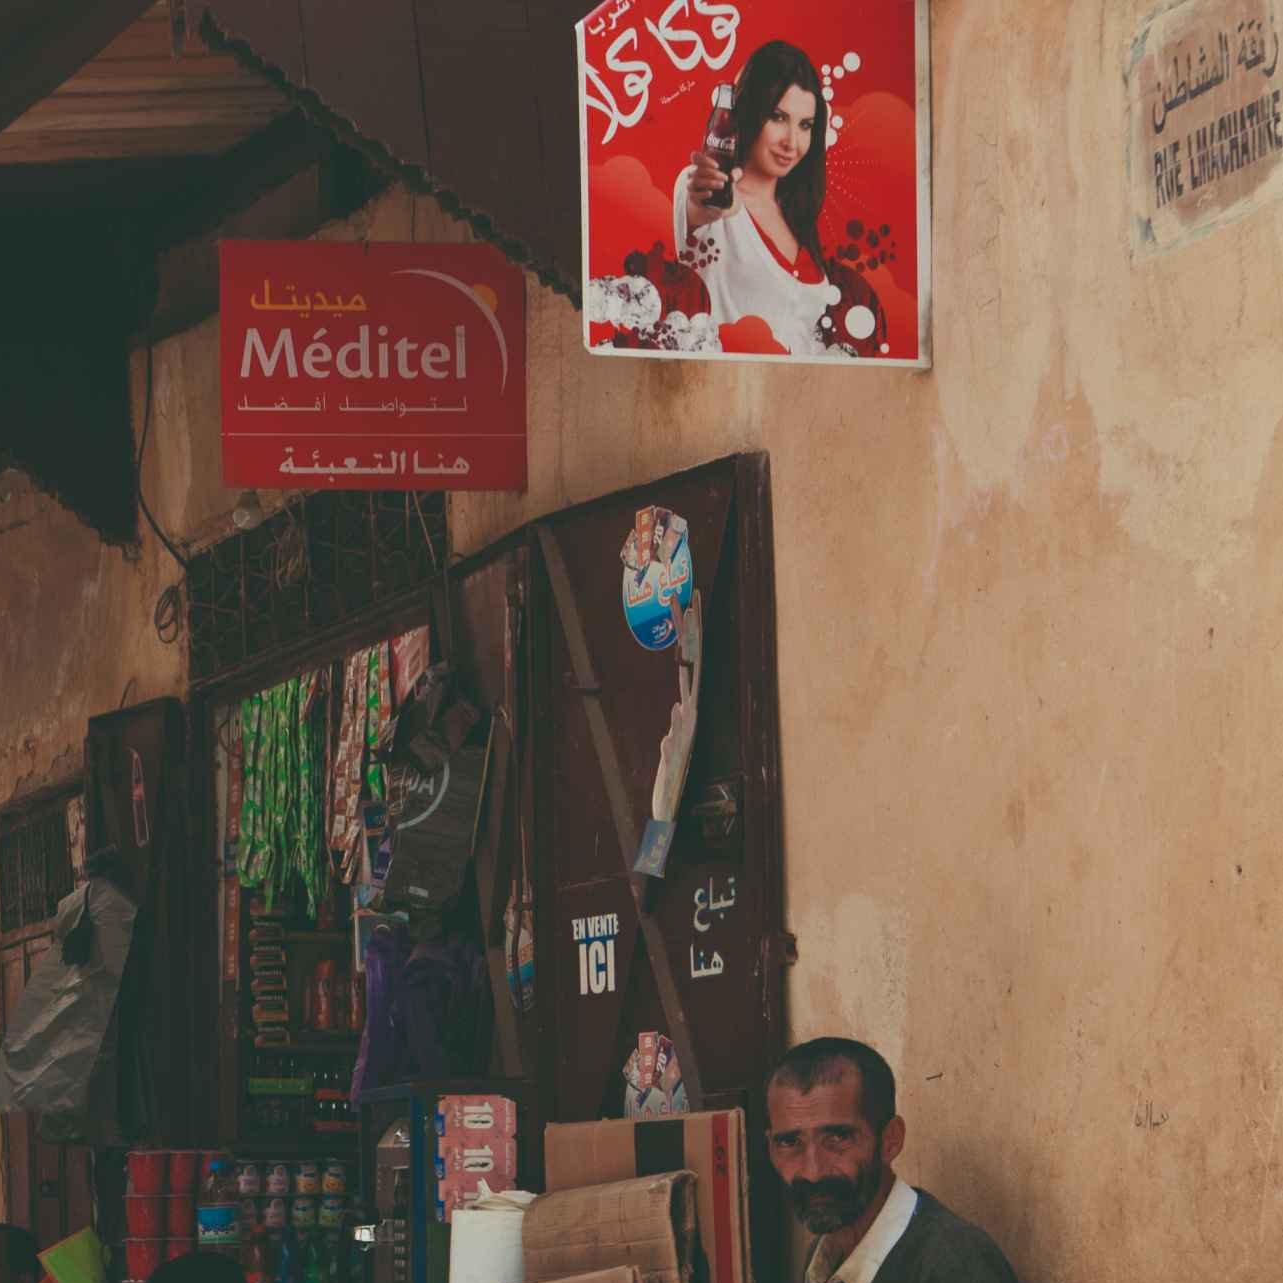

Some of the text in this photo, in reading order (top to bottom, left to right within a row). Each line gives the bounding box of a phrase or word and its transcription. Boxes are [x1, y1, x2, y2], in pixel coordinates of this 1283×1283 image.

[1154, 140, 1184, 209] RUE
[250, 279, 368, 319] ميديتل
[240, 324, 467, 380] Méditel
[279, 446, 470, 482] هنا التعبئة
[658, 558, 689, 607] تباع
[693, 877, 736, 932] تباع
[571, 913, 620, 940] EN VENTE
[578, 940, 617, 995] ICI
[689, 943, 724, 979] هنا
[463, 1101, 494, 1129] 10
[463, 1144, 495, 1173] 10
